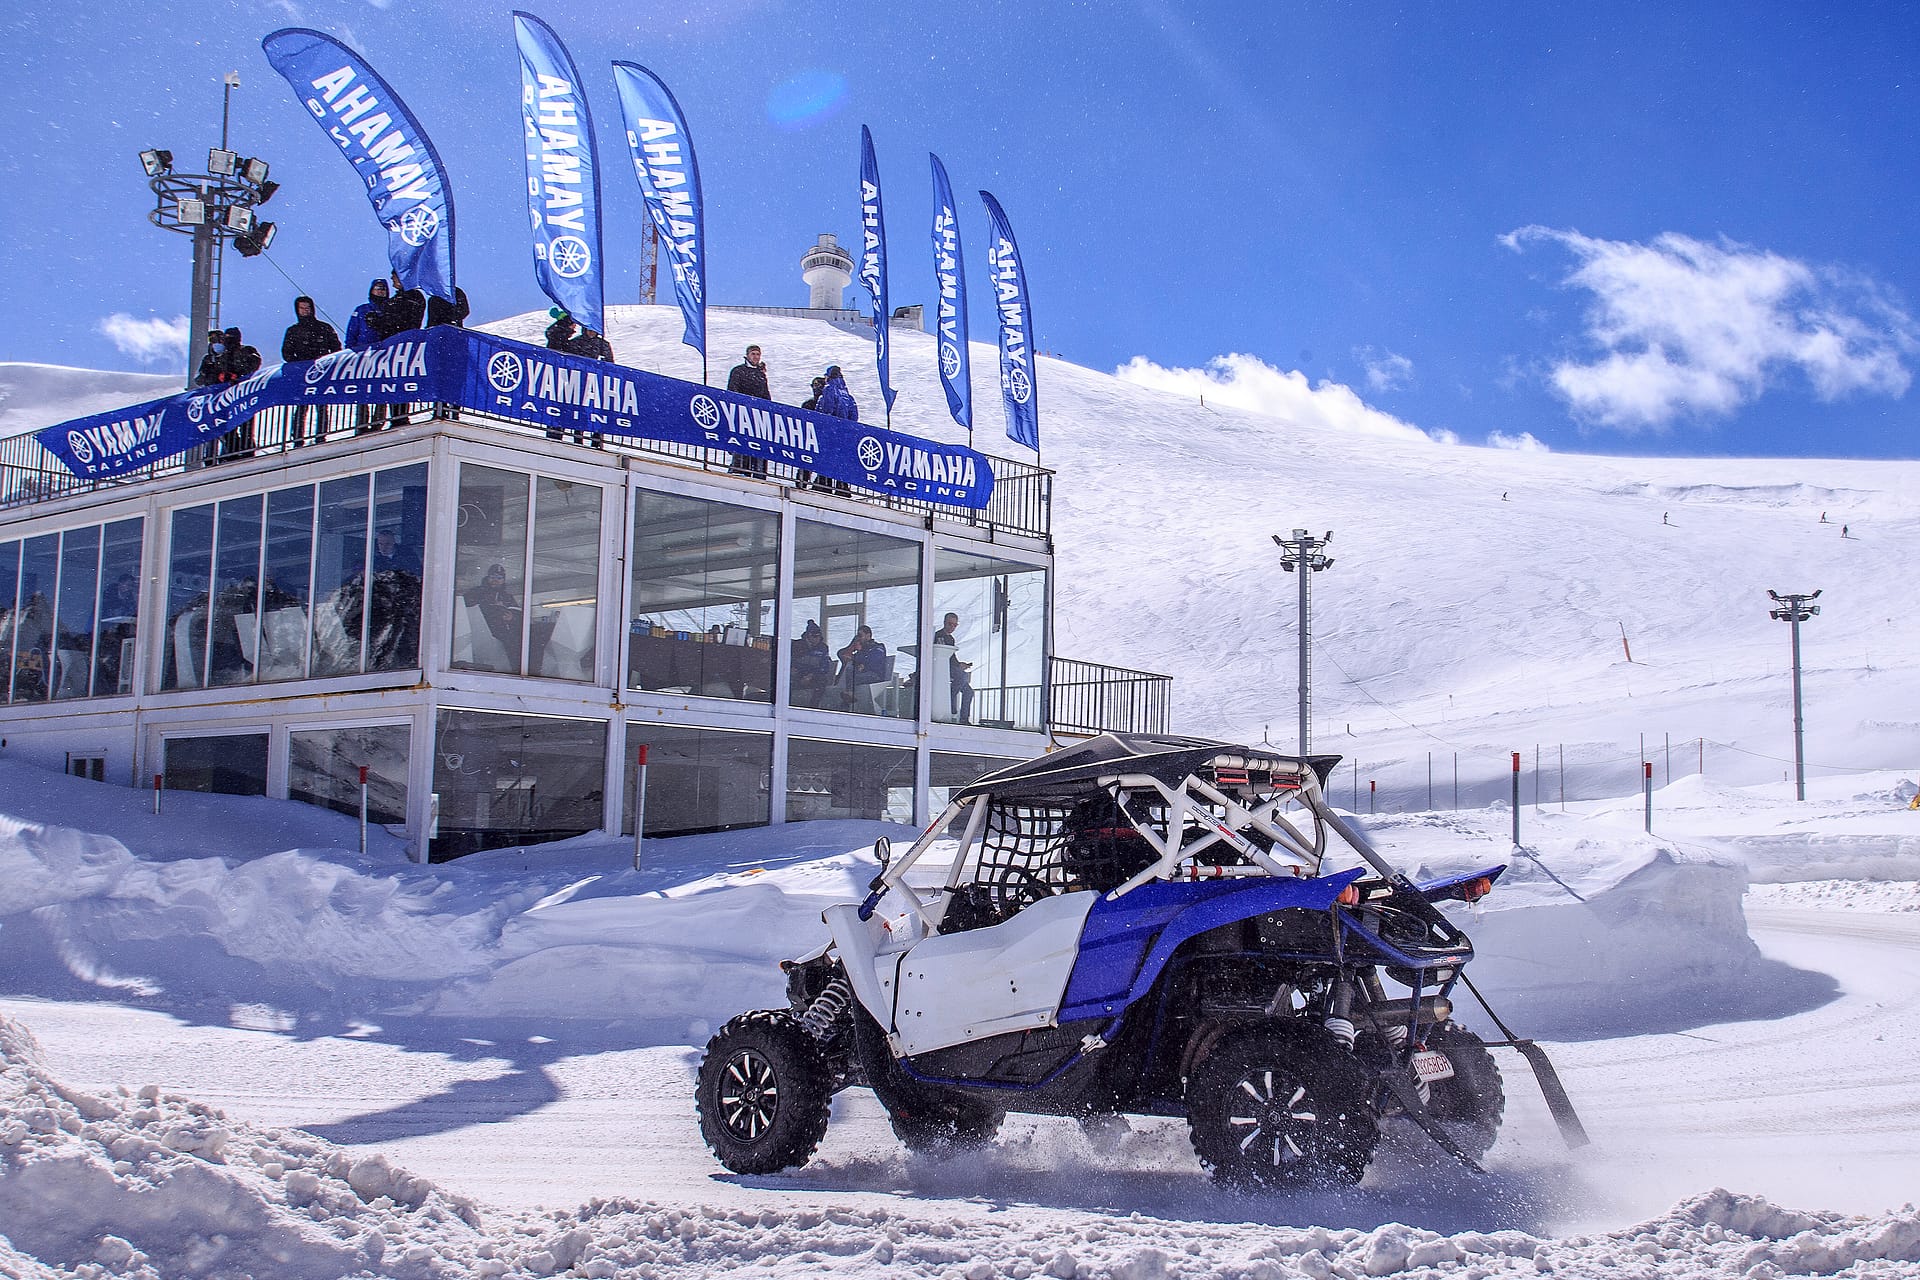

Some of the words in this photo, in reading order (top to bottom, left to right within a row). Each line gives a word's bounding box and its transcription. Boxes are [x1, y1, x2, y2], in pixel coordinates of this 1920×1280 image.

[331, 341, 428, 381] YAMAHA
[304, 383, 419, 395] RACING
[526, 358, 640, 417] YAMAHA
[197, 396, 259, 433] RACING
[496, 394, 632, 428] RACING
[719, 400, 820, 454] YAMAHA
[84, 408, 166, 458] YAMAHA
[705, 431, 813, 464] RACING
[87, 443, 158, 474] RACING
[886, 441, 976, 488] YAMAHA
[866, 473, 967, 498] RACING
